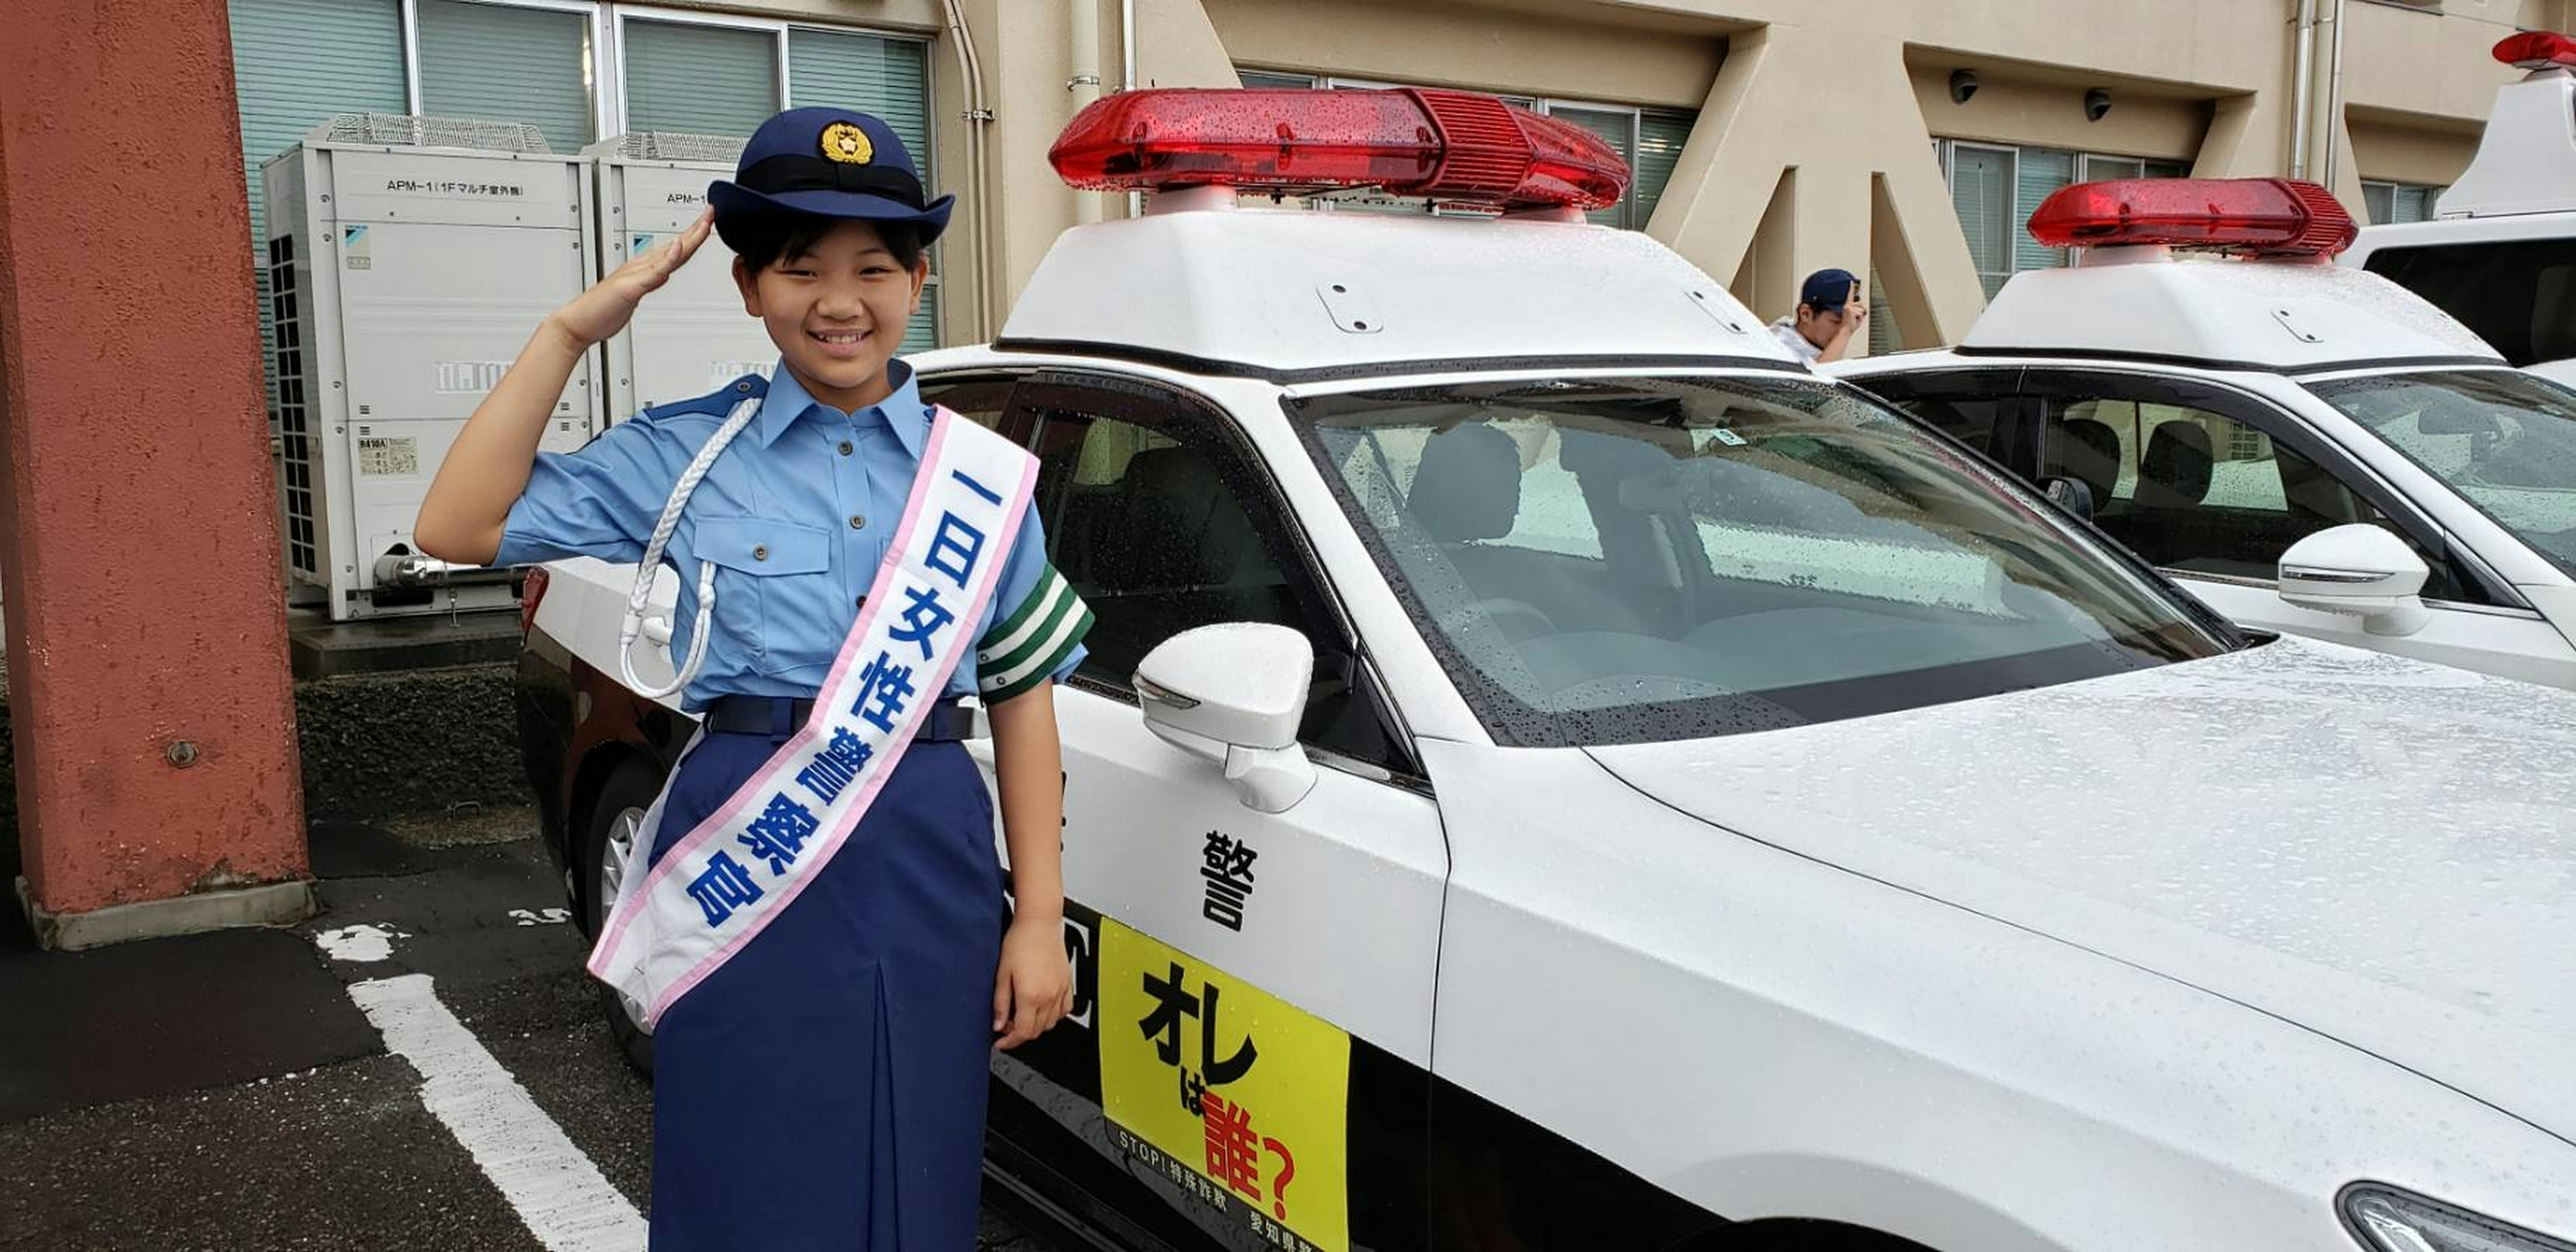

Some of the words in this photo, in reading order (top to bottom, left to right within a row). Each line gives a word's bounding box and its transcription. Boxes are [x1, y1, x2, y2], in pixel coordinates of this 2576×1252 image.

[687, 469, 1002, 928] 一日女性警察官
[1200, 831, 1258, 932] 警
